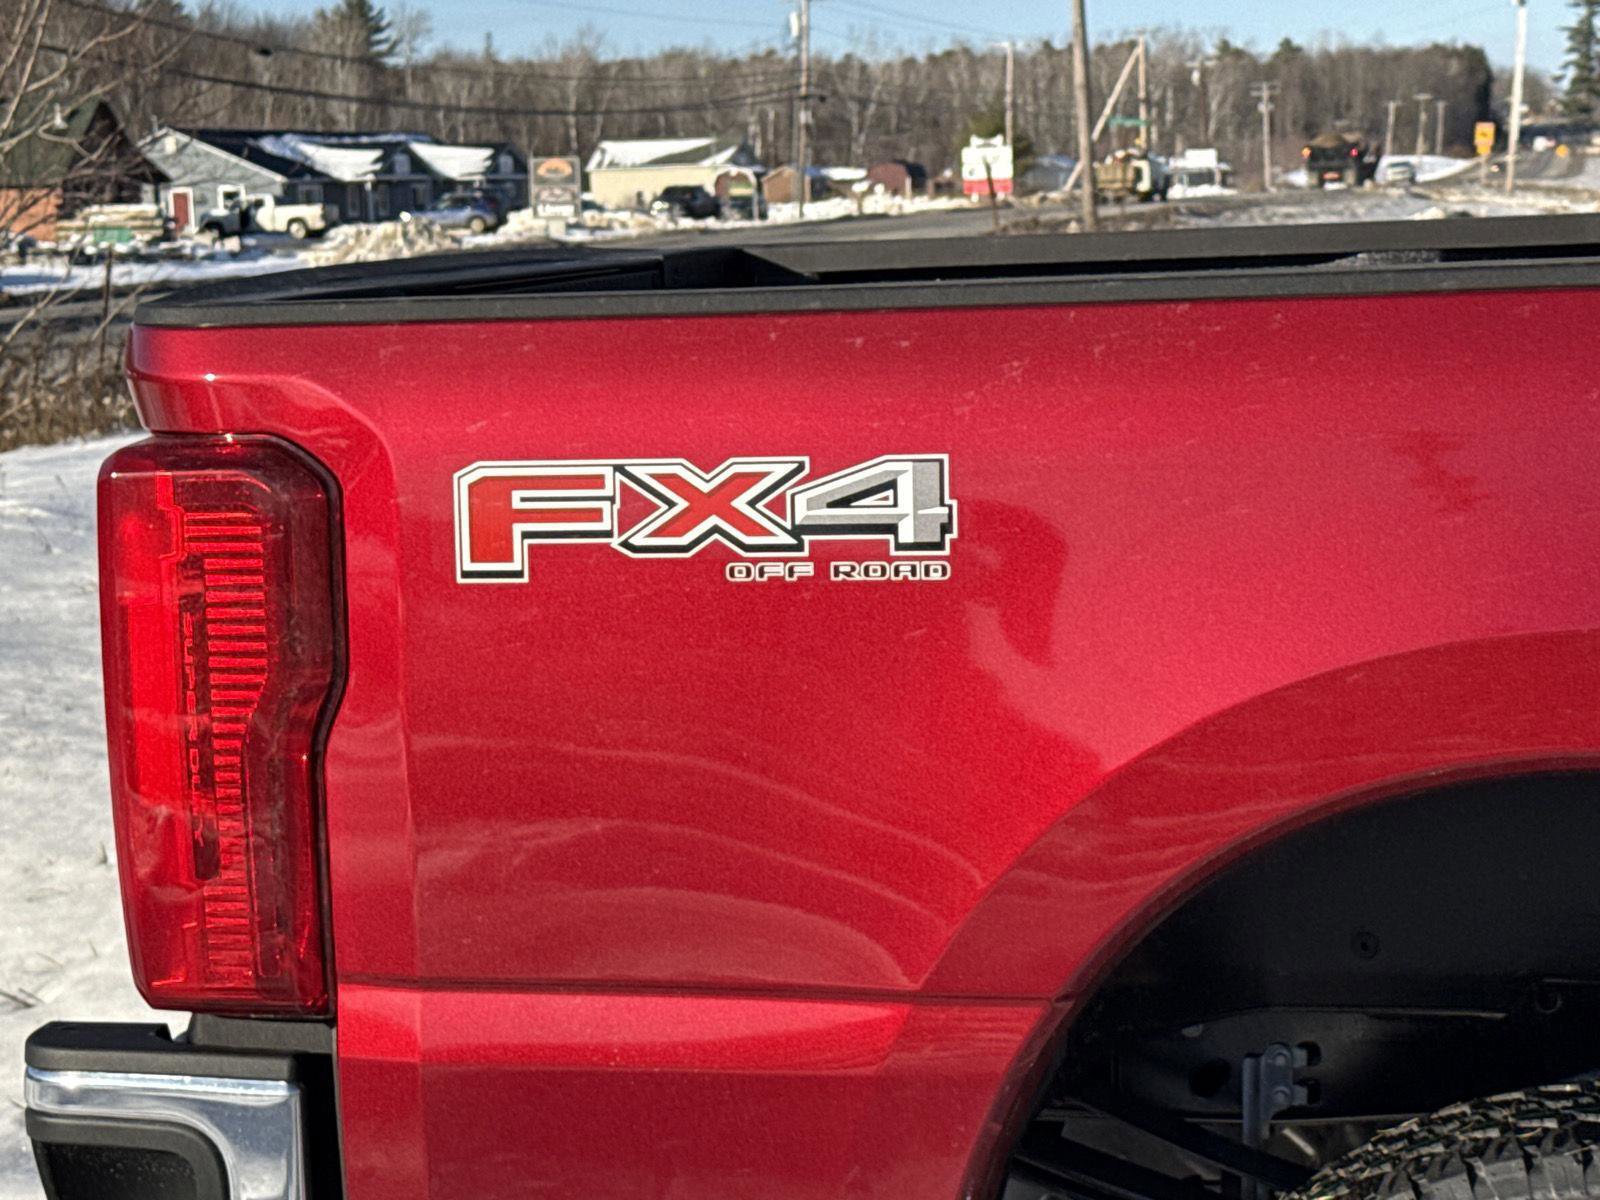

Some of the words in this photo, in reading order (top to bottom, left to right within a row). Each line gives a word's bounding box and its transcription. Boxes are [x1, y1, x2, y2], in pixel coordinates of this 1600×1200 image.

[453, 454, 958, 584] FX4
[726, 562, 814, 581] OFF
[830, 561, 951, 581] ROAD
